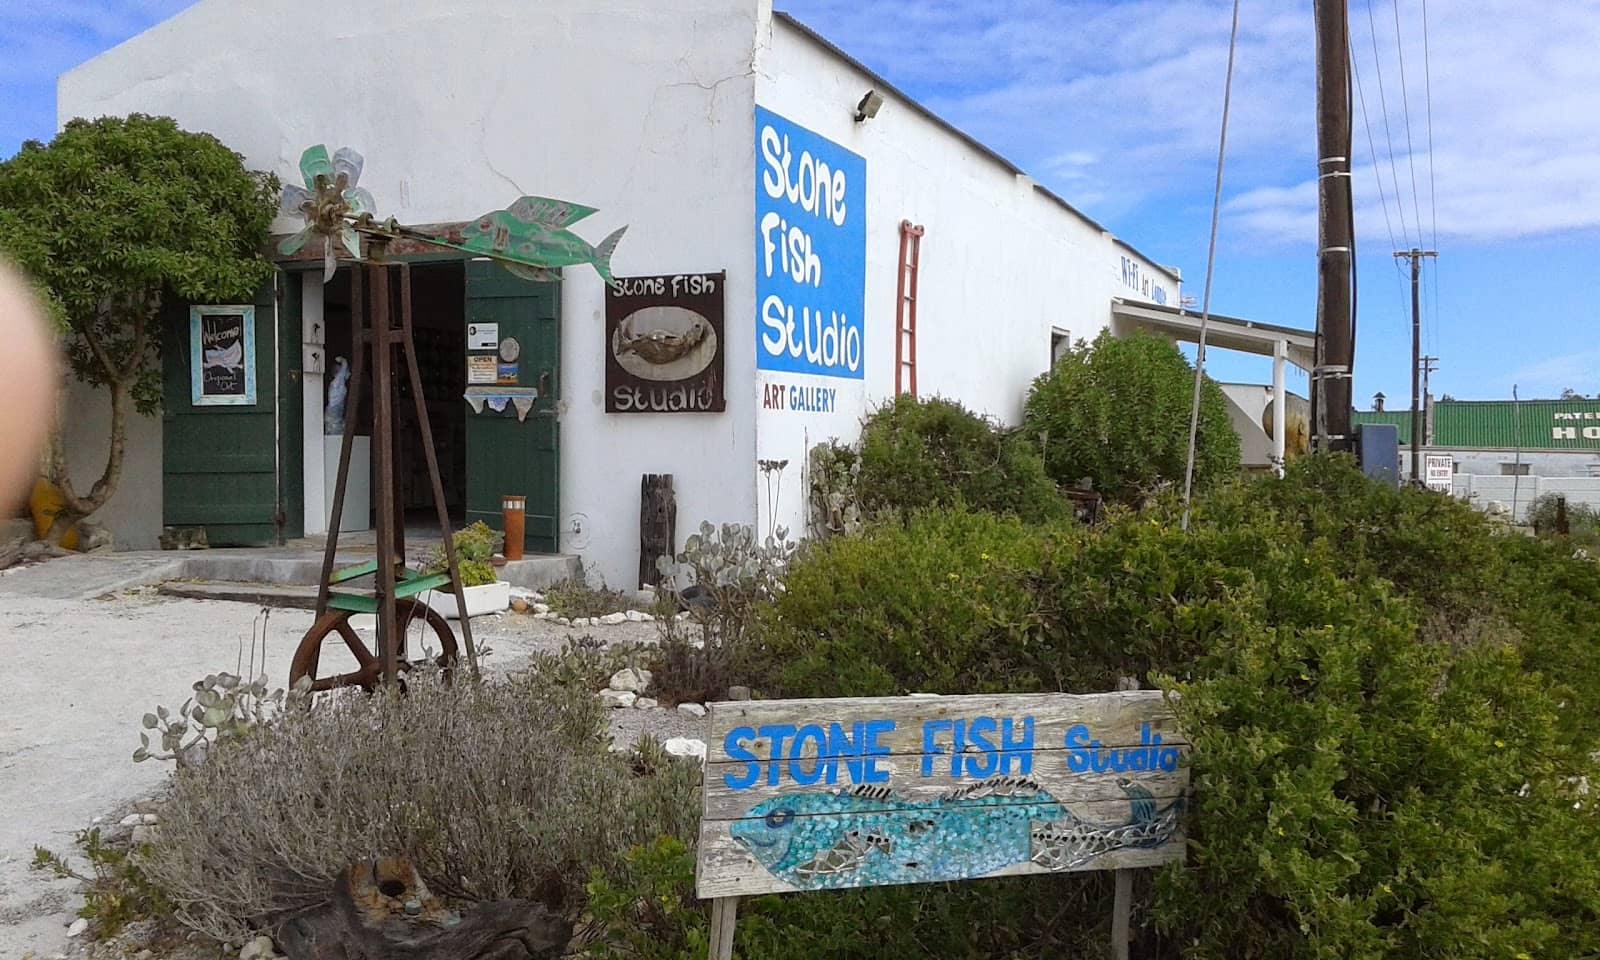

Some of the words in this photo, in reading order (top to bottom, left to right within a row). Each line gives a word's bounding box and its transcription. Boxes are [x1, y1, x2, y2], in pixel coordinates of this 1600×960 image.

[761, 125, 847, 227] Stone
[761, 212, 821, 289] Fish
[671, 275, 715, 298] Fish
[761, 294, 860, 372] Studio
[613, 384, 713, 411] Studio
[763, 383, 785, 410] ART
[789, 385, 836, 413] GALLERY
[1427, 458, 1451, 468] PRIVATE
[723, 719, 896, 790] STONE
[921, 715, 1034, 778] FISH
[1064, 721, 1179, 773] Studio
